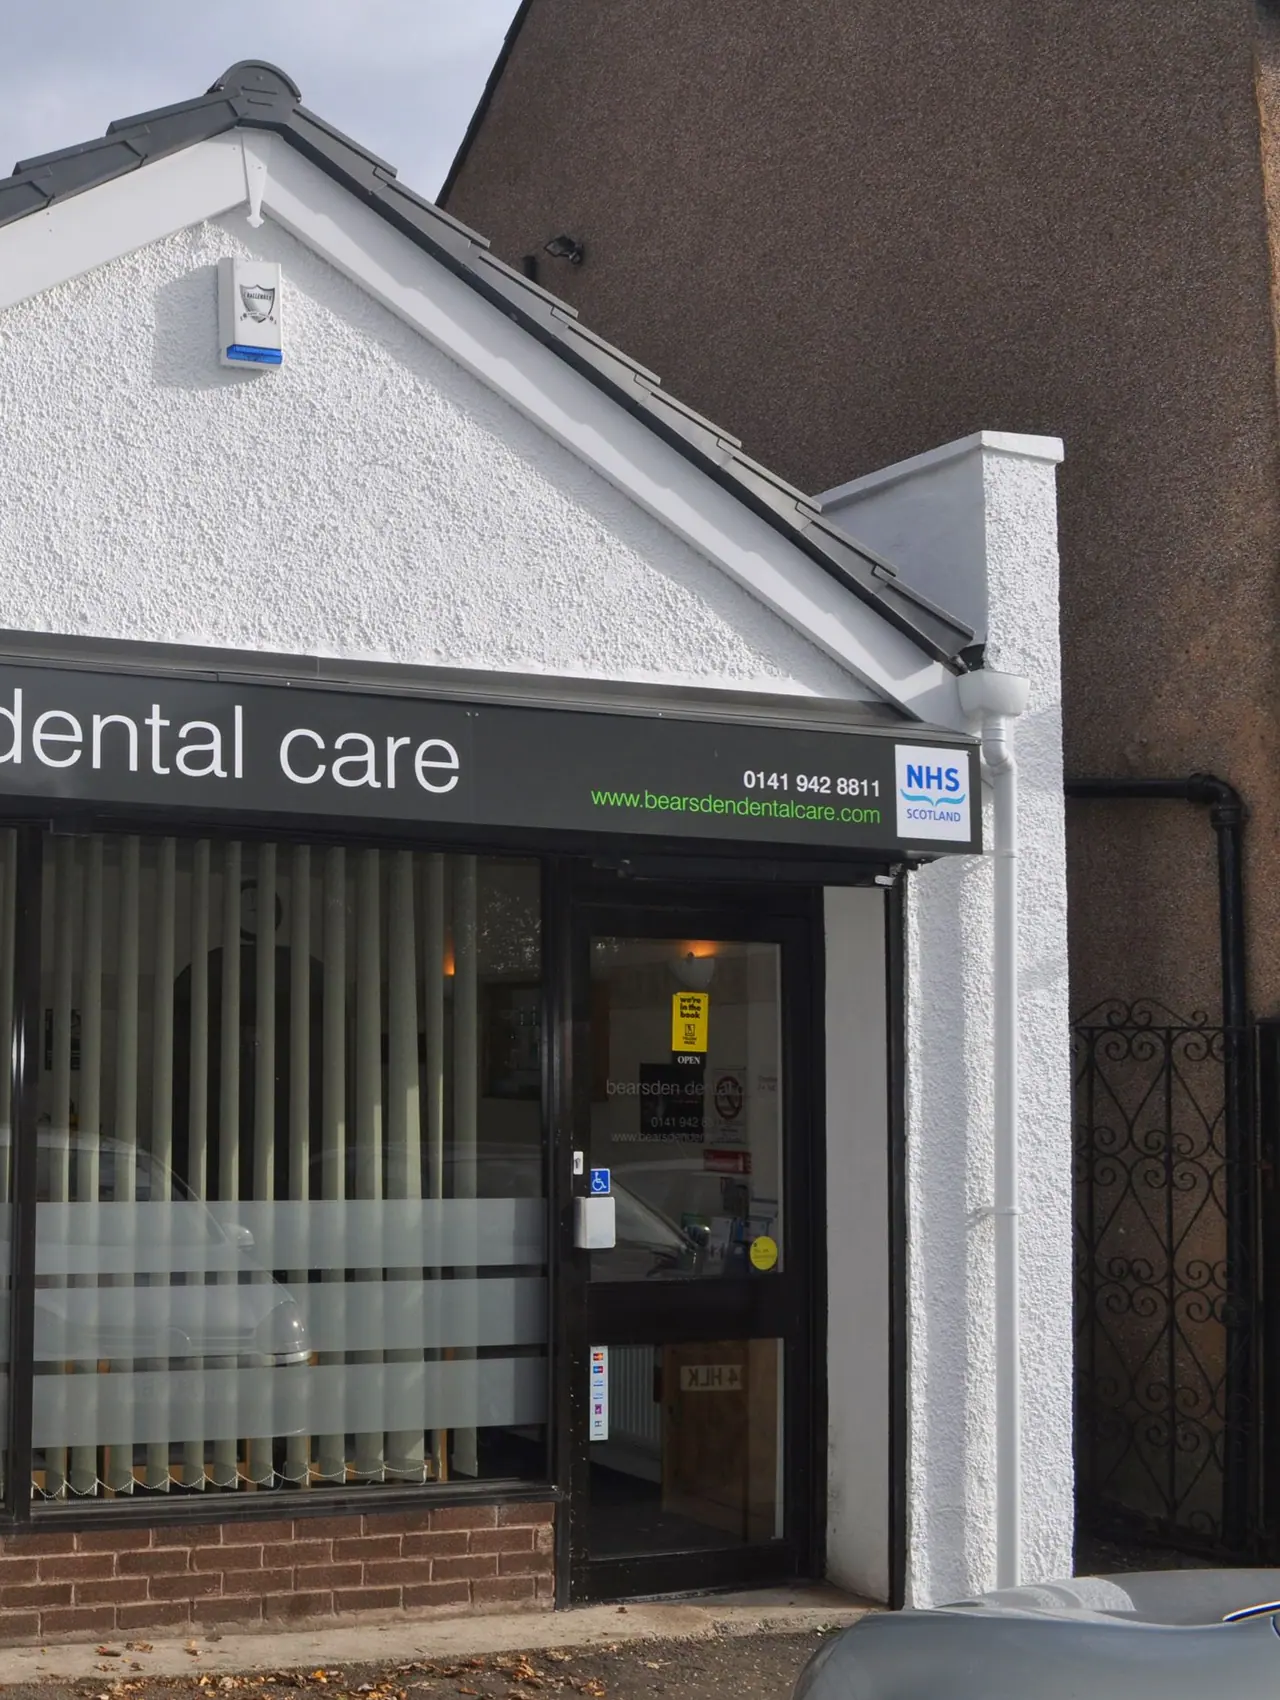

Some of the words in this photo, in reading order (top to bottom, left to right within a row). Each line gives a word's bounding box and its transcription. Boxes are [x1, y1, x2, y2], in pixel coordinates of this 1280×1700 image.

[279, 728, 460, 794] care
[743, 770, 788, 791] 0141
[796, 774, 832, 794] 942
[836, 777, 880, 797] 8811
[906, 764, 961, 792] NHS
[591, 789, 881, 824] www.bearsdendentalcare.com
[906, 808, 961, 823] SCOTLAND
[677, 1055, 701, 1065] OPEN
[606, 1079, 680, 1096] bearsden
[650, 1116, 677, 1128] 0141
[679, 1116, 699, 1128] 942
